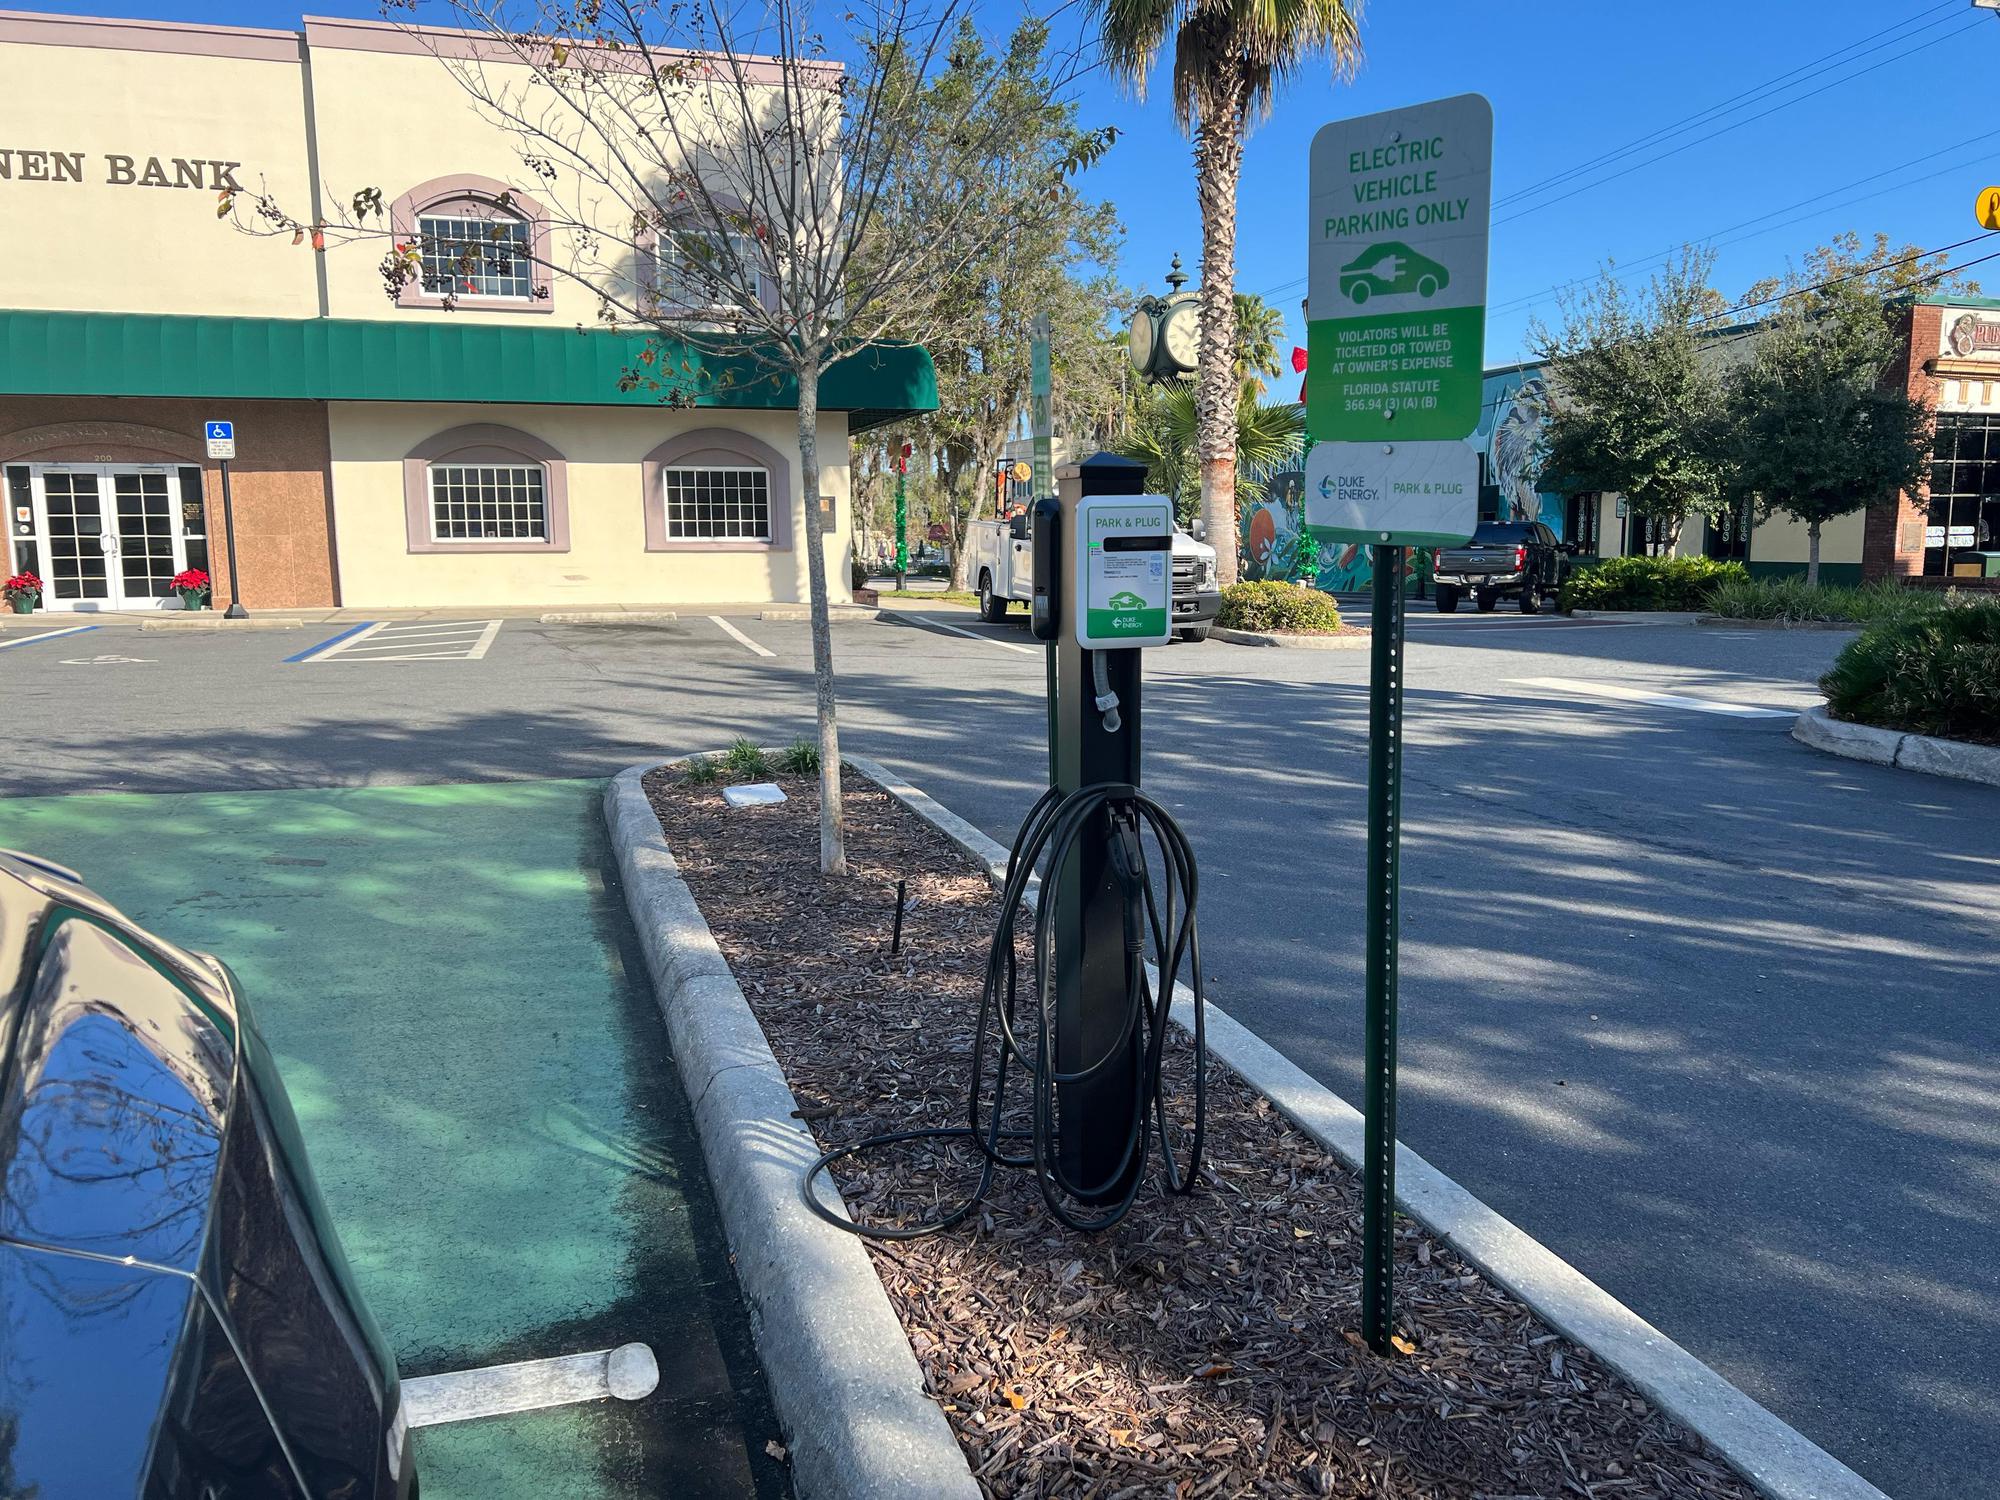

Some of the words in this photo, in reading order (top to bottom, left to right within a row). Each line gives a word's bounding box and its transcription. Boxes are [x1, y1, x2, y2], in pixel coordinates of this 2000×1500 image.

[1350, 137, 1443, 173] ELECTRIC
[104, 154, 243, 192] BANK
[1354, 171, 1437, 203] VEHICLE
[1325, 208, 1409, 239] PARKING
[1416, 198, 1469, 225] ONLY
[1339, 328, 1398, 343] VIOLATORS
[1401, 325, 1429, 338] WILL
[1433, 323, 1448, 336] BE
[1335, 344, 1387, 358] TICKETED
[1390, 343, 1405, 355] OR
[1409, 340, 1451, 354] TOWED
[1332, 363, 1345, 375] AT
[1348, 359, 1398, 374] OWNER'S
[1401, 356, 1453, 370] EXPENSE
[1343, 383, 1389, 396] FLORIDA
[1392, 380, 1440, 393] STATUTE
[1344, 399, 1382, 411] 366.94
[1385, 398, 1400, 411] (3)
[1403, 397, 1418, 409] (A)
[1421, 396, 1437, 409] (B)
[1338, 476, 1365, 488] DUKE
[1393, 483, 1421, 494] PARK
[1424, 483, 1431, 494] &
[1434, 483, 1463, 494] PLUG
[1095, 518, 1122, 528] PARK
[1125, 518, 1132, 528] &
[1135, 517, 1161, 527] PLUG
